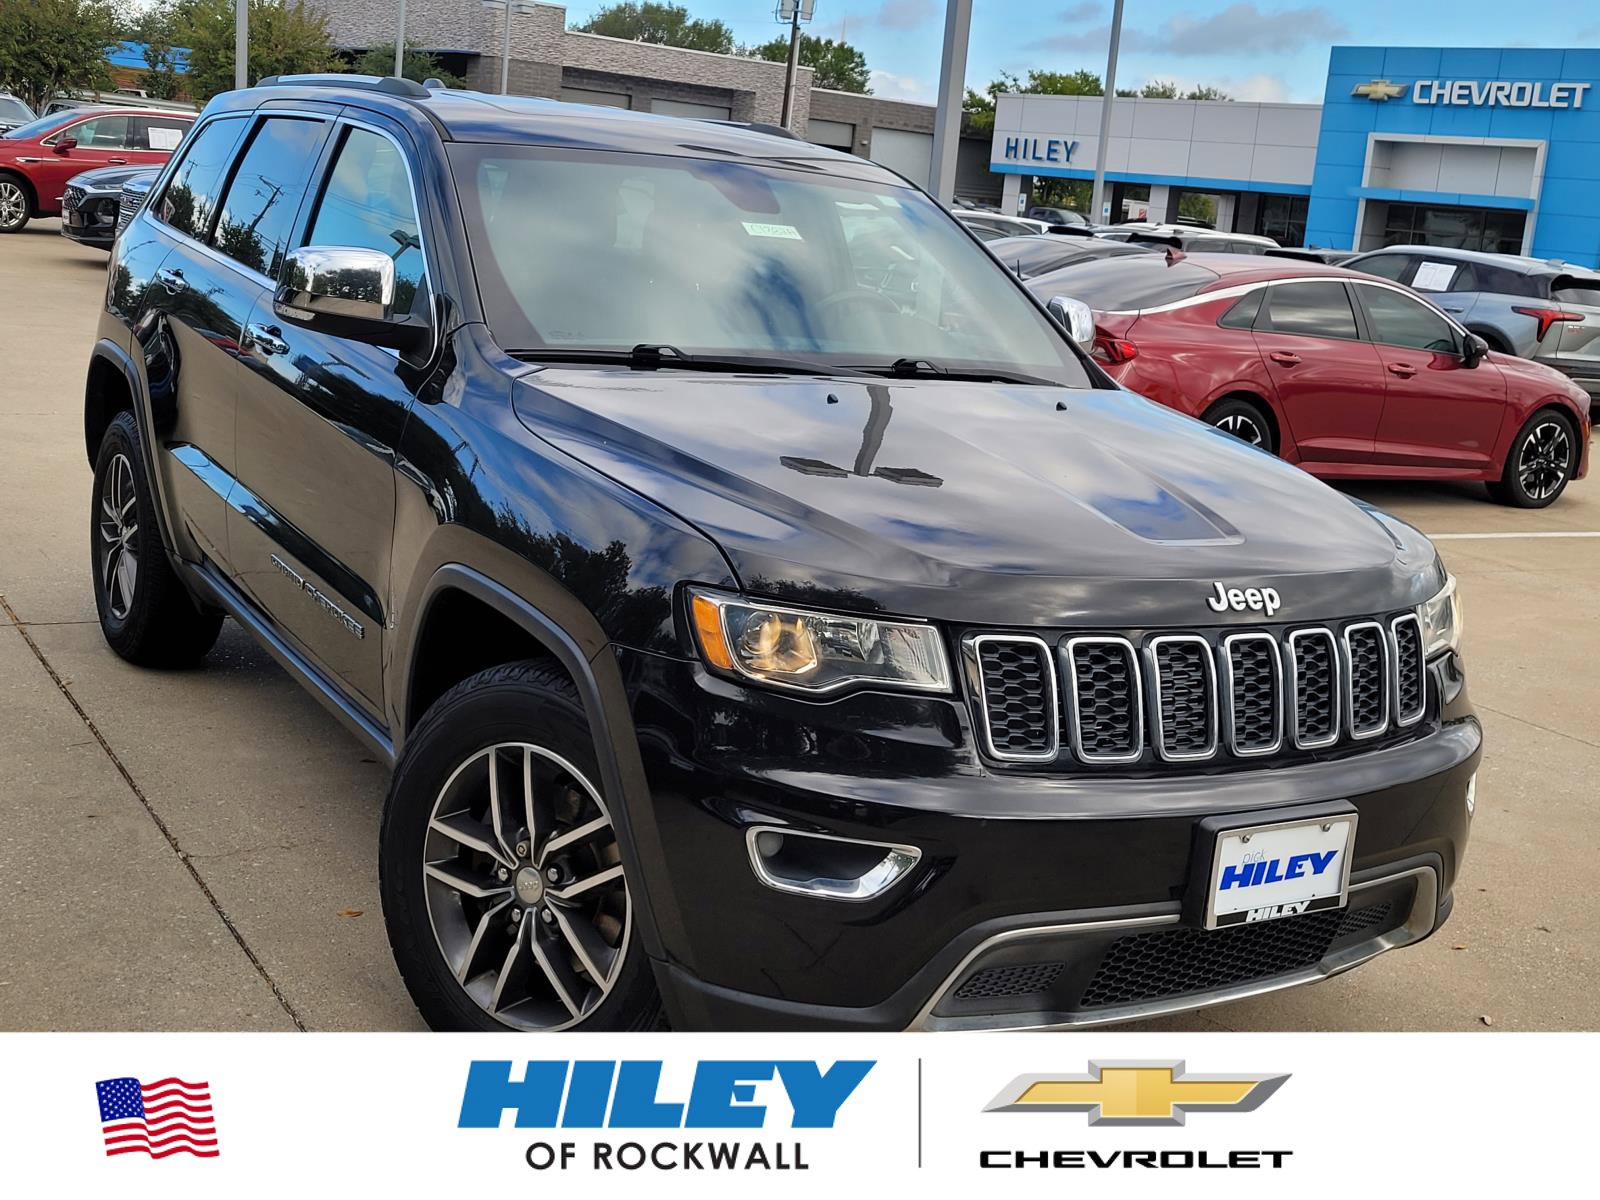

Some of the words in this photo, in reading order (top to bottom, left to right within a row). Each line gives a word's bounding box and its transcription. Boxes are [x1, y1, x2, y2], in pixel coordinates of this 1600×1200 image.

[1413, 79, 1591, 109] CHEVROLET
[1005, 137, 1077, 162] HILEY
[271, 554, 305, 590] GRAND
[305, 583, 364, 640] CHEROKEE
[1206, 581, 1282, 617] Jeep
[1219, 850, 1338, 891] HILEY
[1246, 900, 1312, 923] HILEY
